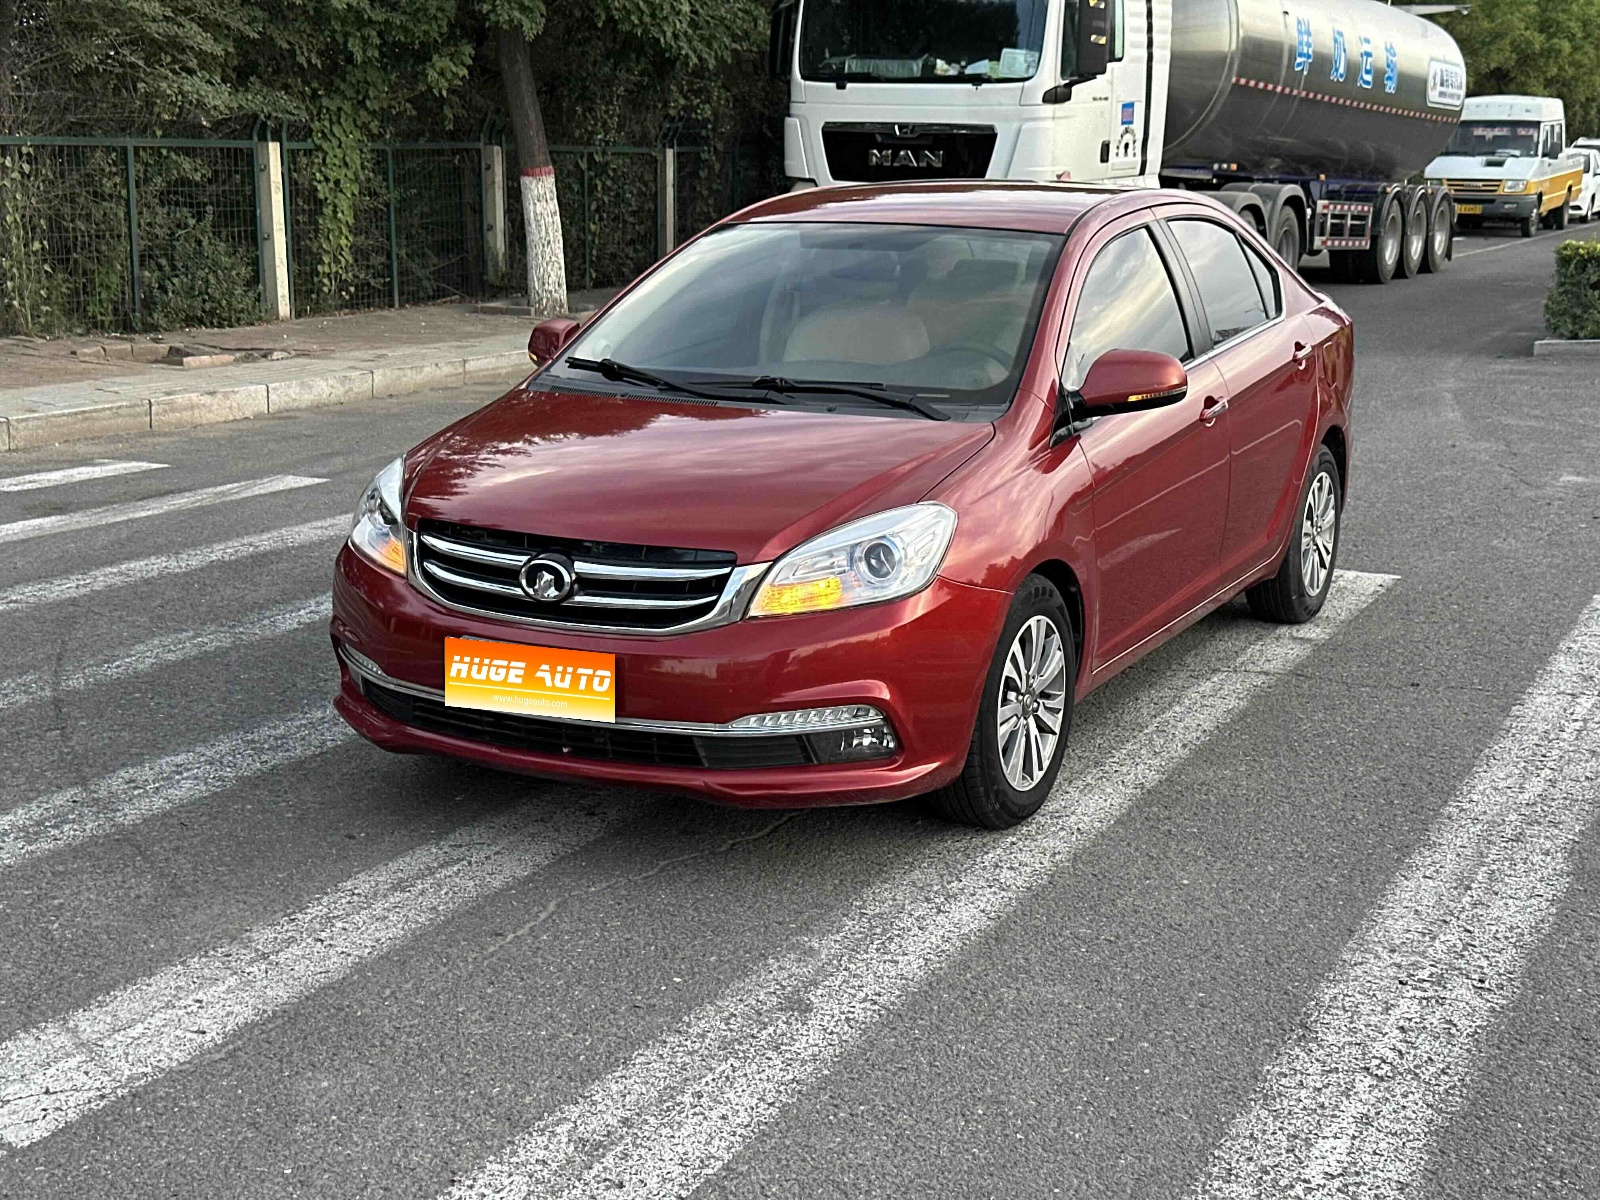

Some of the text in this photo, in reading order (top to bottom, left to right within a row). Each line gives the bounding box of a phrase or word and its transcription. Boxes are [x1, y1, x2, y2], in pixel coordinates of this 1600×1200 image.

[1294, 16, 1398, 94] 鲜奶运输
[868, 148, 944, 168] MAN
